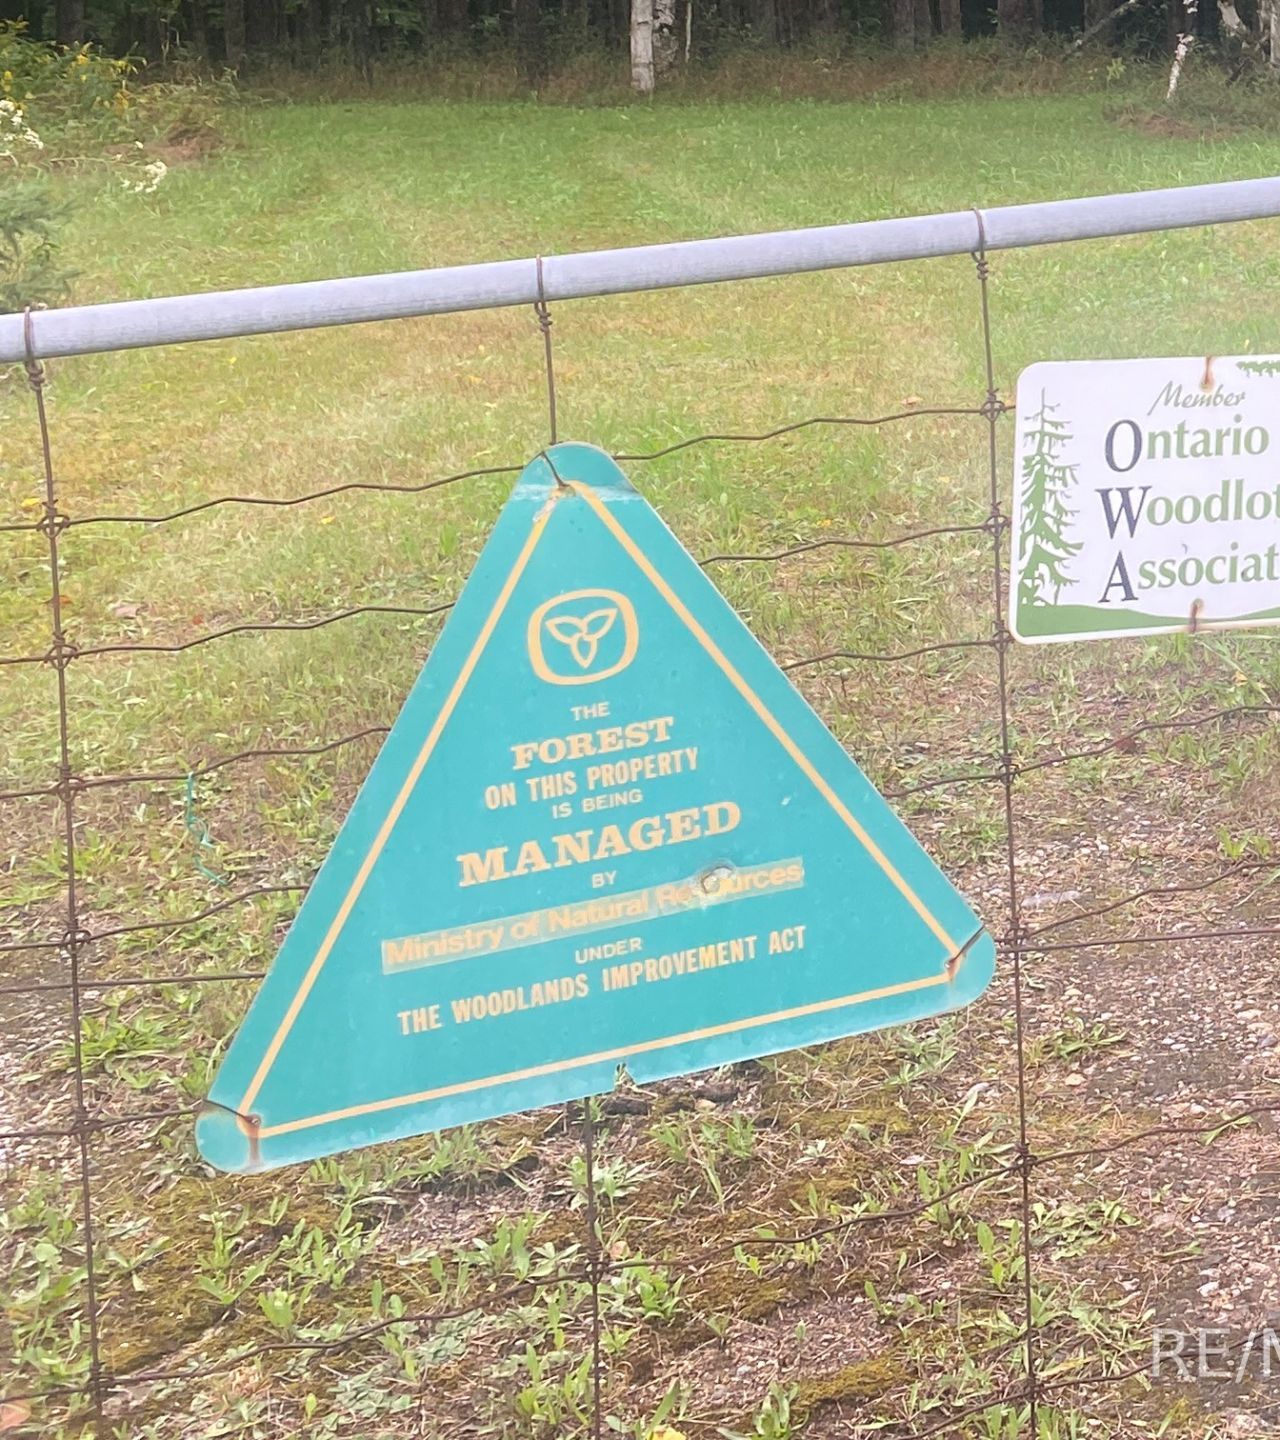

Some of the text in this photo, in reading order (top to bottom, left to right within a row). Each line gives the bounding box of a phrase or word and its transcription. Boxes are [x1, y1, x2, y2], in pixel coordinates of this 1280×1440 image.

[1147, 380, 1246, 416] Member
[1104, 414, 1270, 473] Ontario
[570, 702, 610, 721] THE
[510, 716, 674, 770] FOREST
[484, 746, 698, 810] ON THIS PROPERTY
[552, 788, 643, 819] IS BEING
[456, 800, 741, 887] MANAGED
[591, 870, 617, 888] BY
[386, 926, 504, 965] Ministry
[511, 912, 540, 940] of
[549, 890, 649, 932] Natural
[575, 936, 643, 965] UNDER
[397, 925, 806, 1036] THE WOODLANDS IMPROVEMENT ACT
